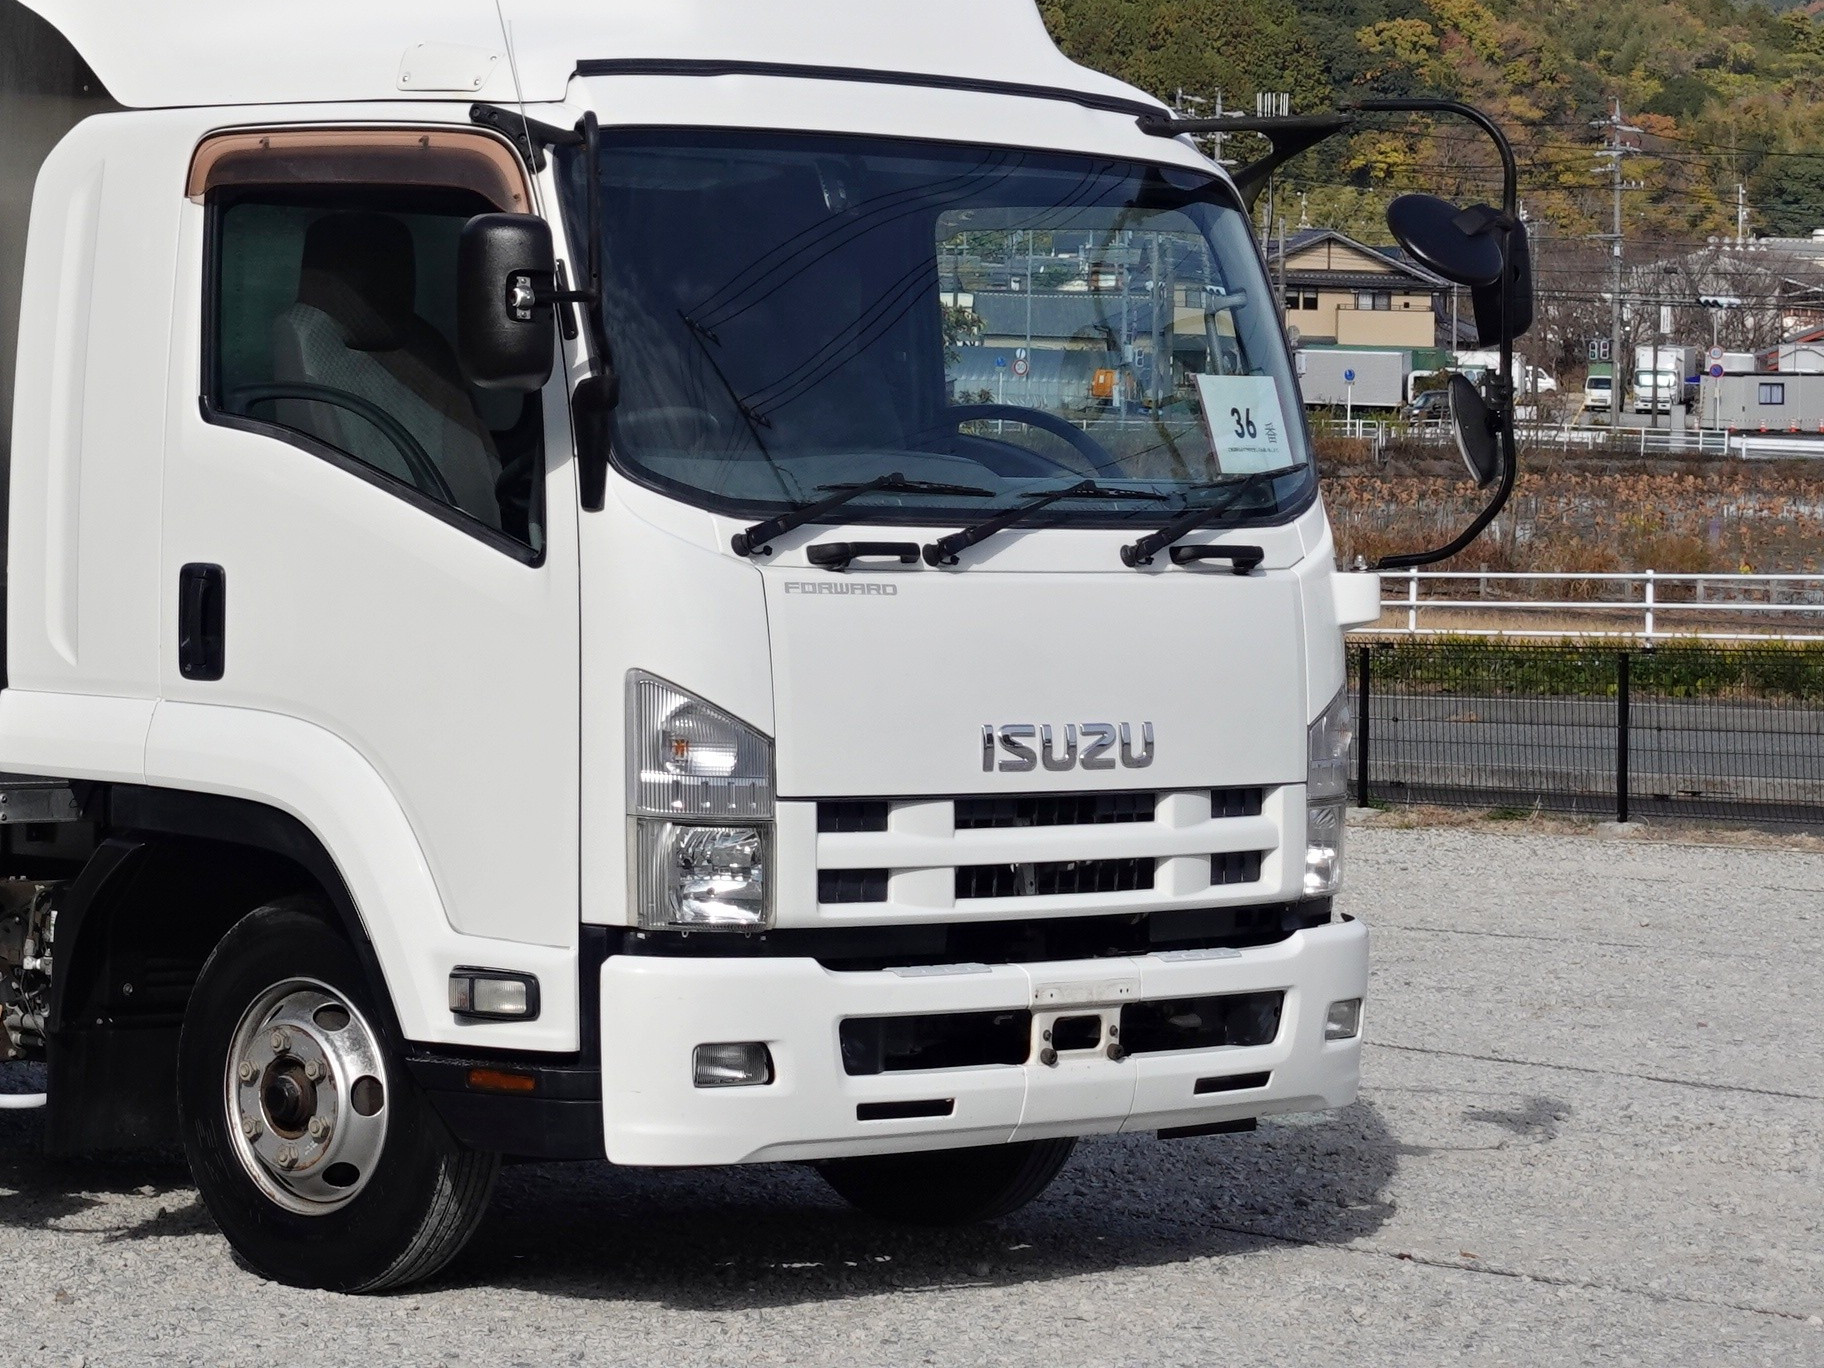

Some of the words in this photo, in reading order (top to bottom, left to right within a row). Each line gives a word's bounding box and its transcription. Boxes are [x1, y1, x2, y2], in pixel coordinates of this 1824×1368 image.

[1230, 407, 1257, 439] 36
[784, 581, 898, 596] FORWARD
[981, 721, 1155, 773] ISUZU
